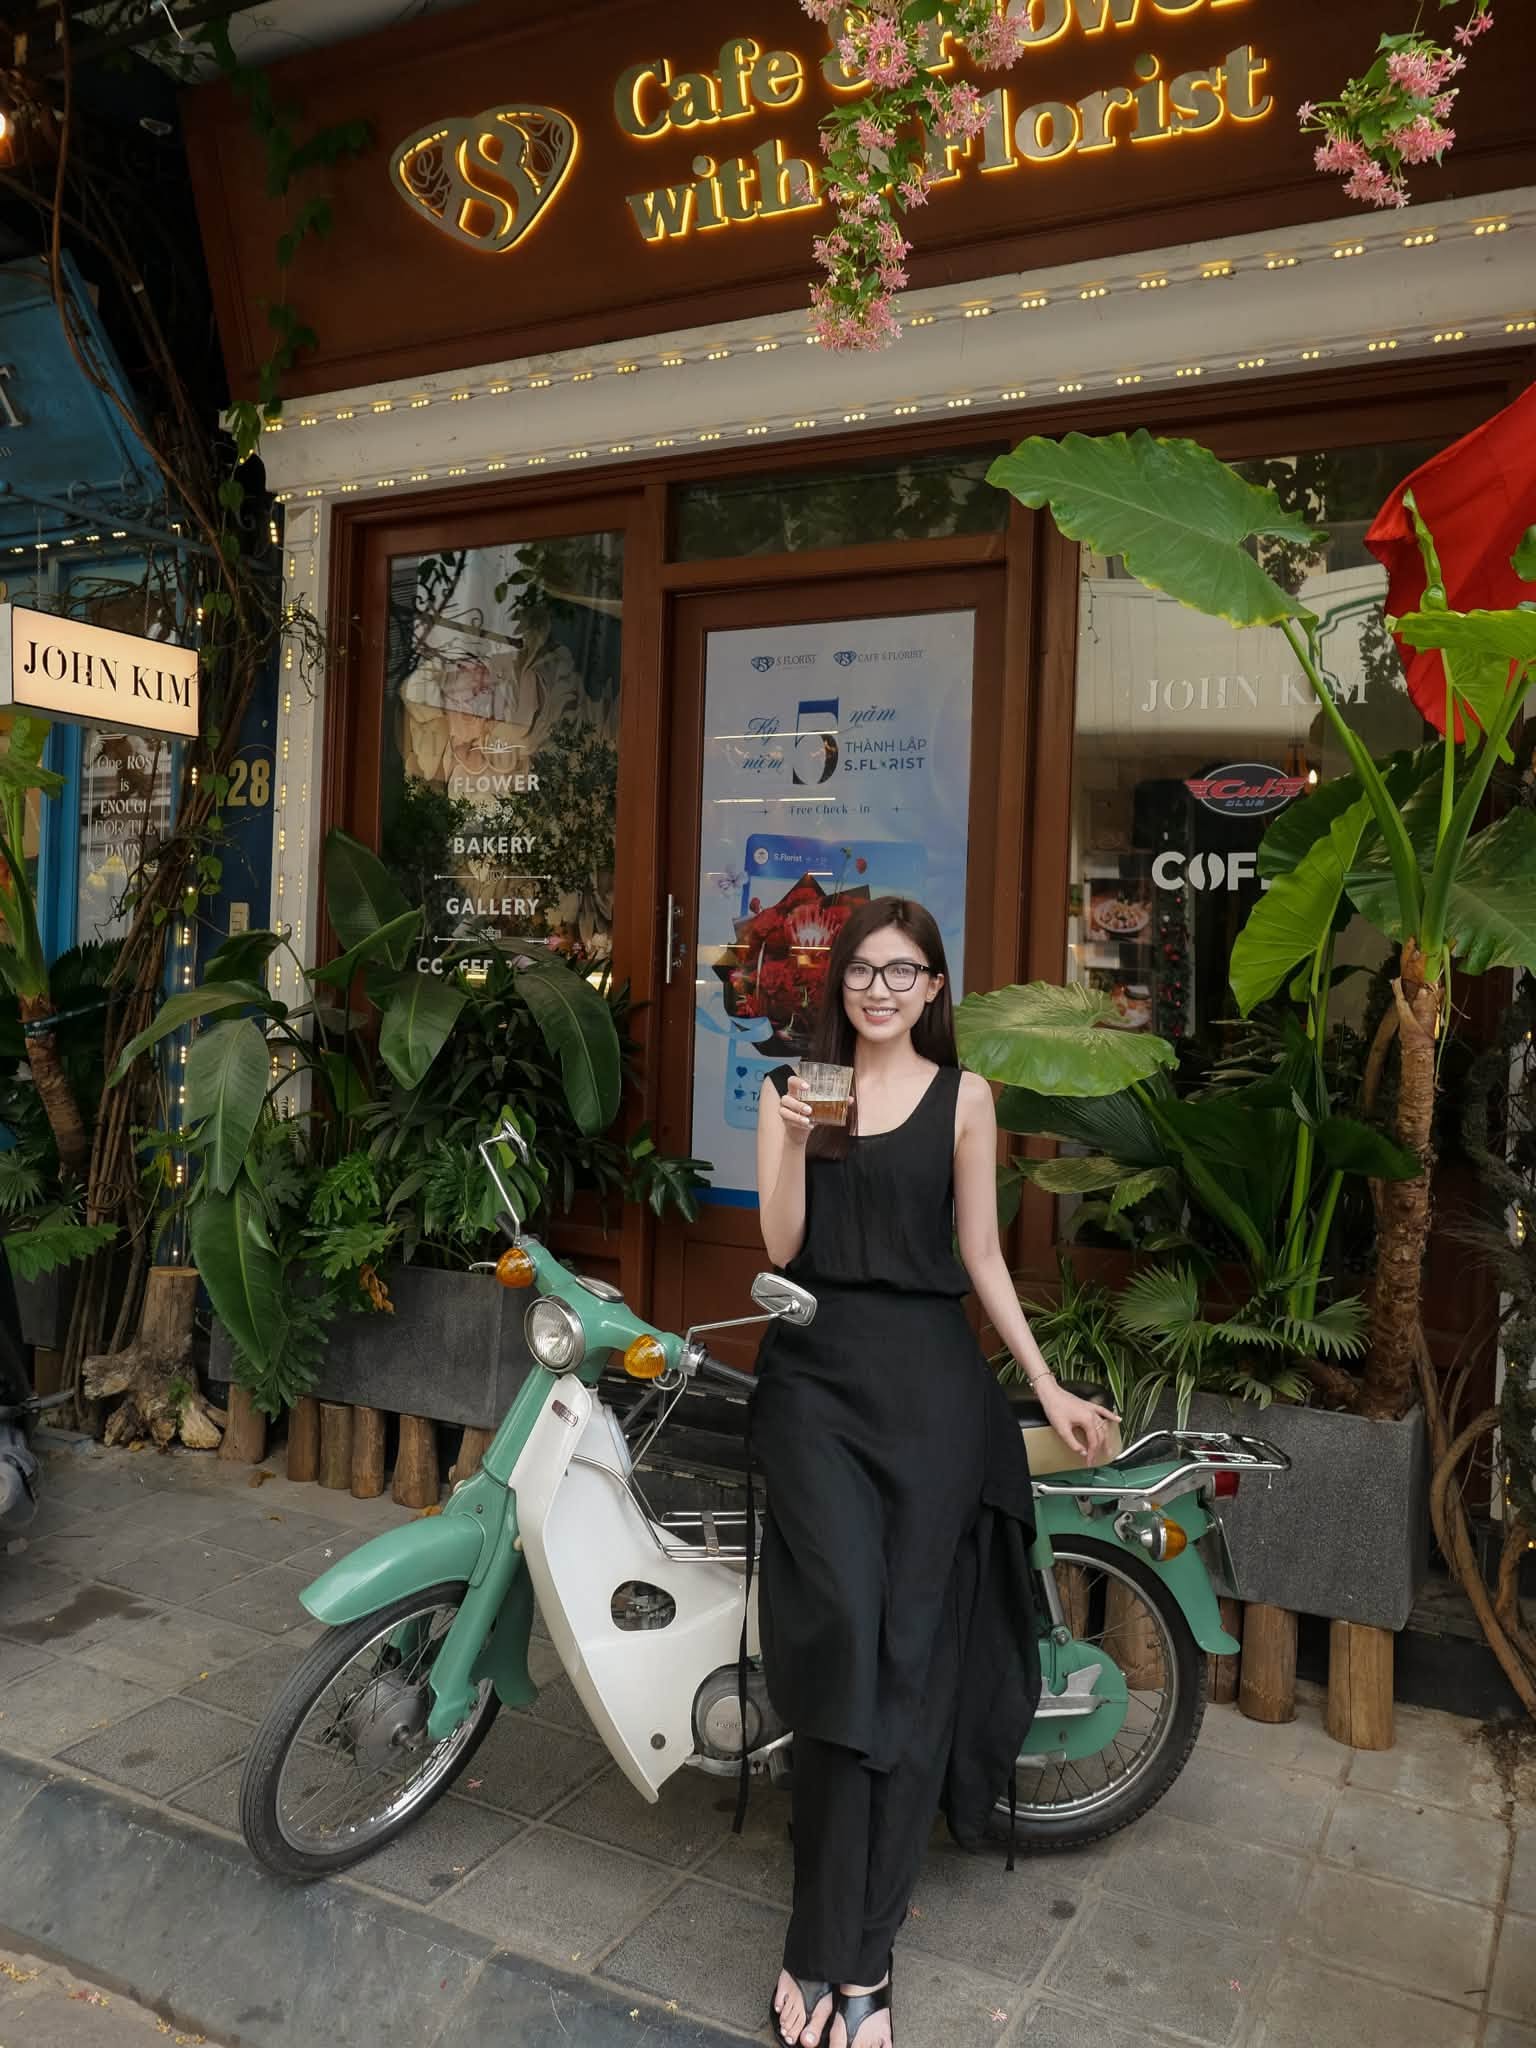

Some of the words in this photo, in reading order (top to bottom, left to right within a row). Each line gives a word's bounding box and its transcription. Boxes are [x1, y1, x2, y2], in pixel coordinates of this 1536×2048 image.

[613, 37, 804, 139] Cafe
[625, 137, 823, 242] with
[23, 639, 120, 693] JOHN
[131, 664, 193, 708] KIM
[1141, 673, 1264, 713] JOHN
[845, 737, 895, 754] THÀNH
[120, 778, 130, 792] is
[452, 774, 541, 793] FLOWER
[453, 836, 537, 855] BAKERY
[445, 897, 540, 916] GALLERY
